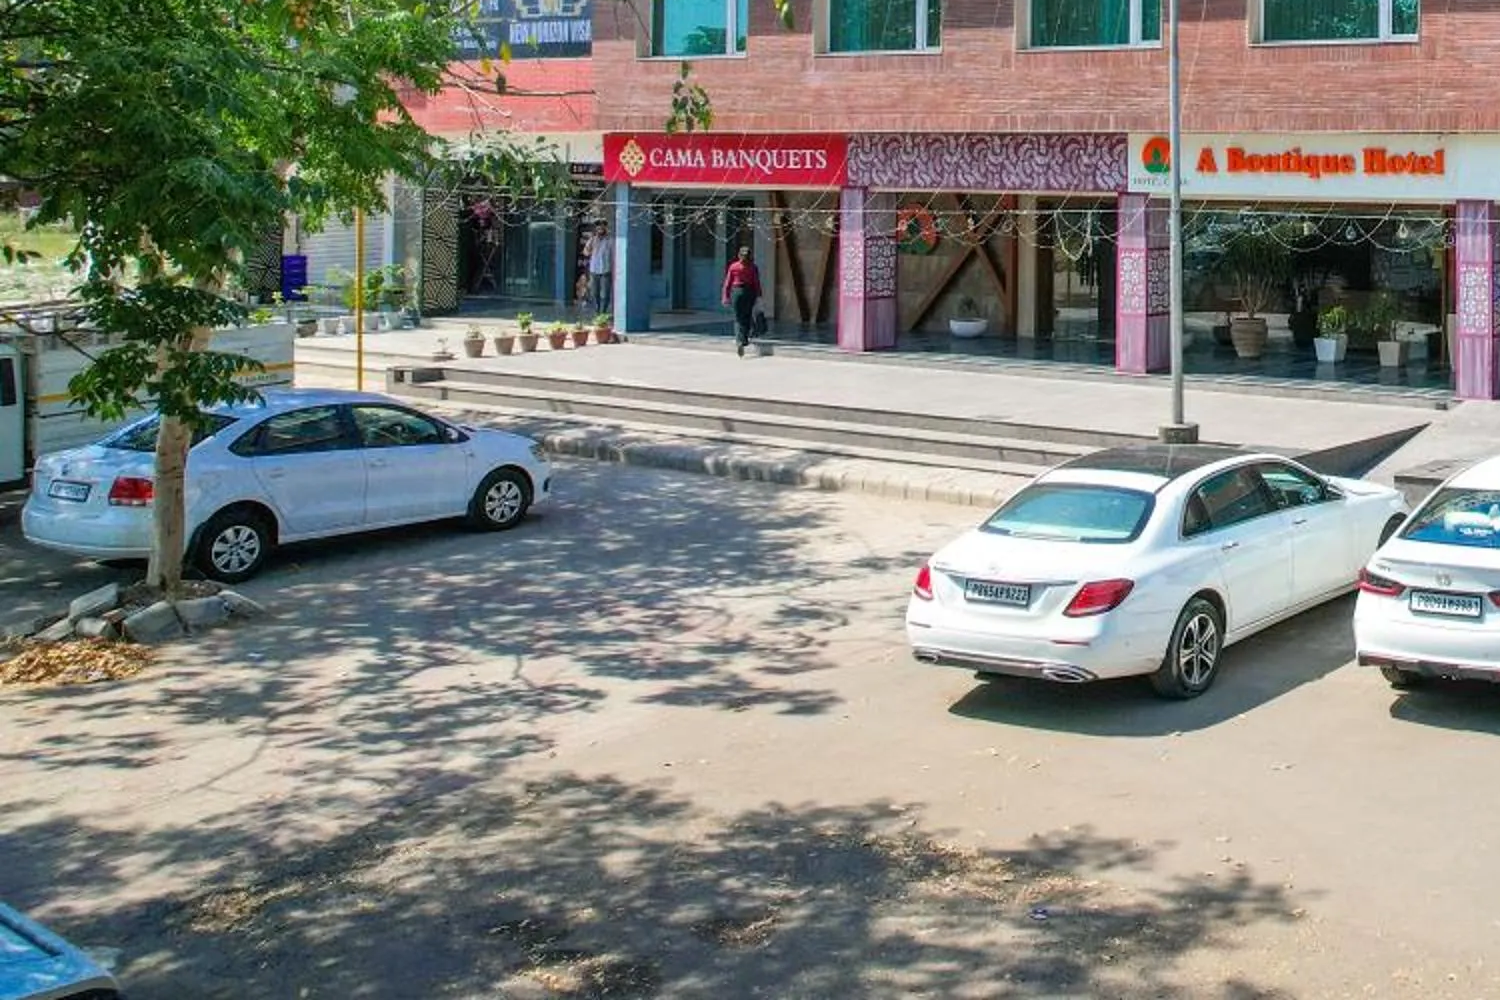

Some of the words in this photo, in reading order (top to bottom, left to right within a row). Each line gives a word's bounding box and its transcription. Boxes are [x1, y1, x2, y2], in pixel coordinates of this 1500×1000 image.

[649, 147, 705, 168] CAMA
[711, 148, 828, 175] BANQUETS
[1196, 146, 1218, 173] A
[1226, 146, 1356, 180] Boutique
[1362, 147, 1445, 175] Hotel
